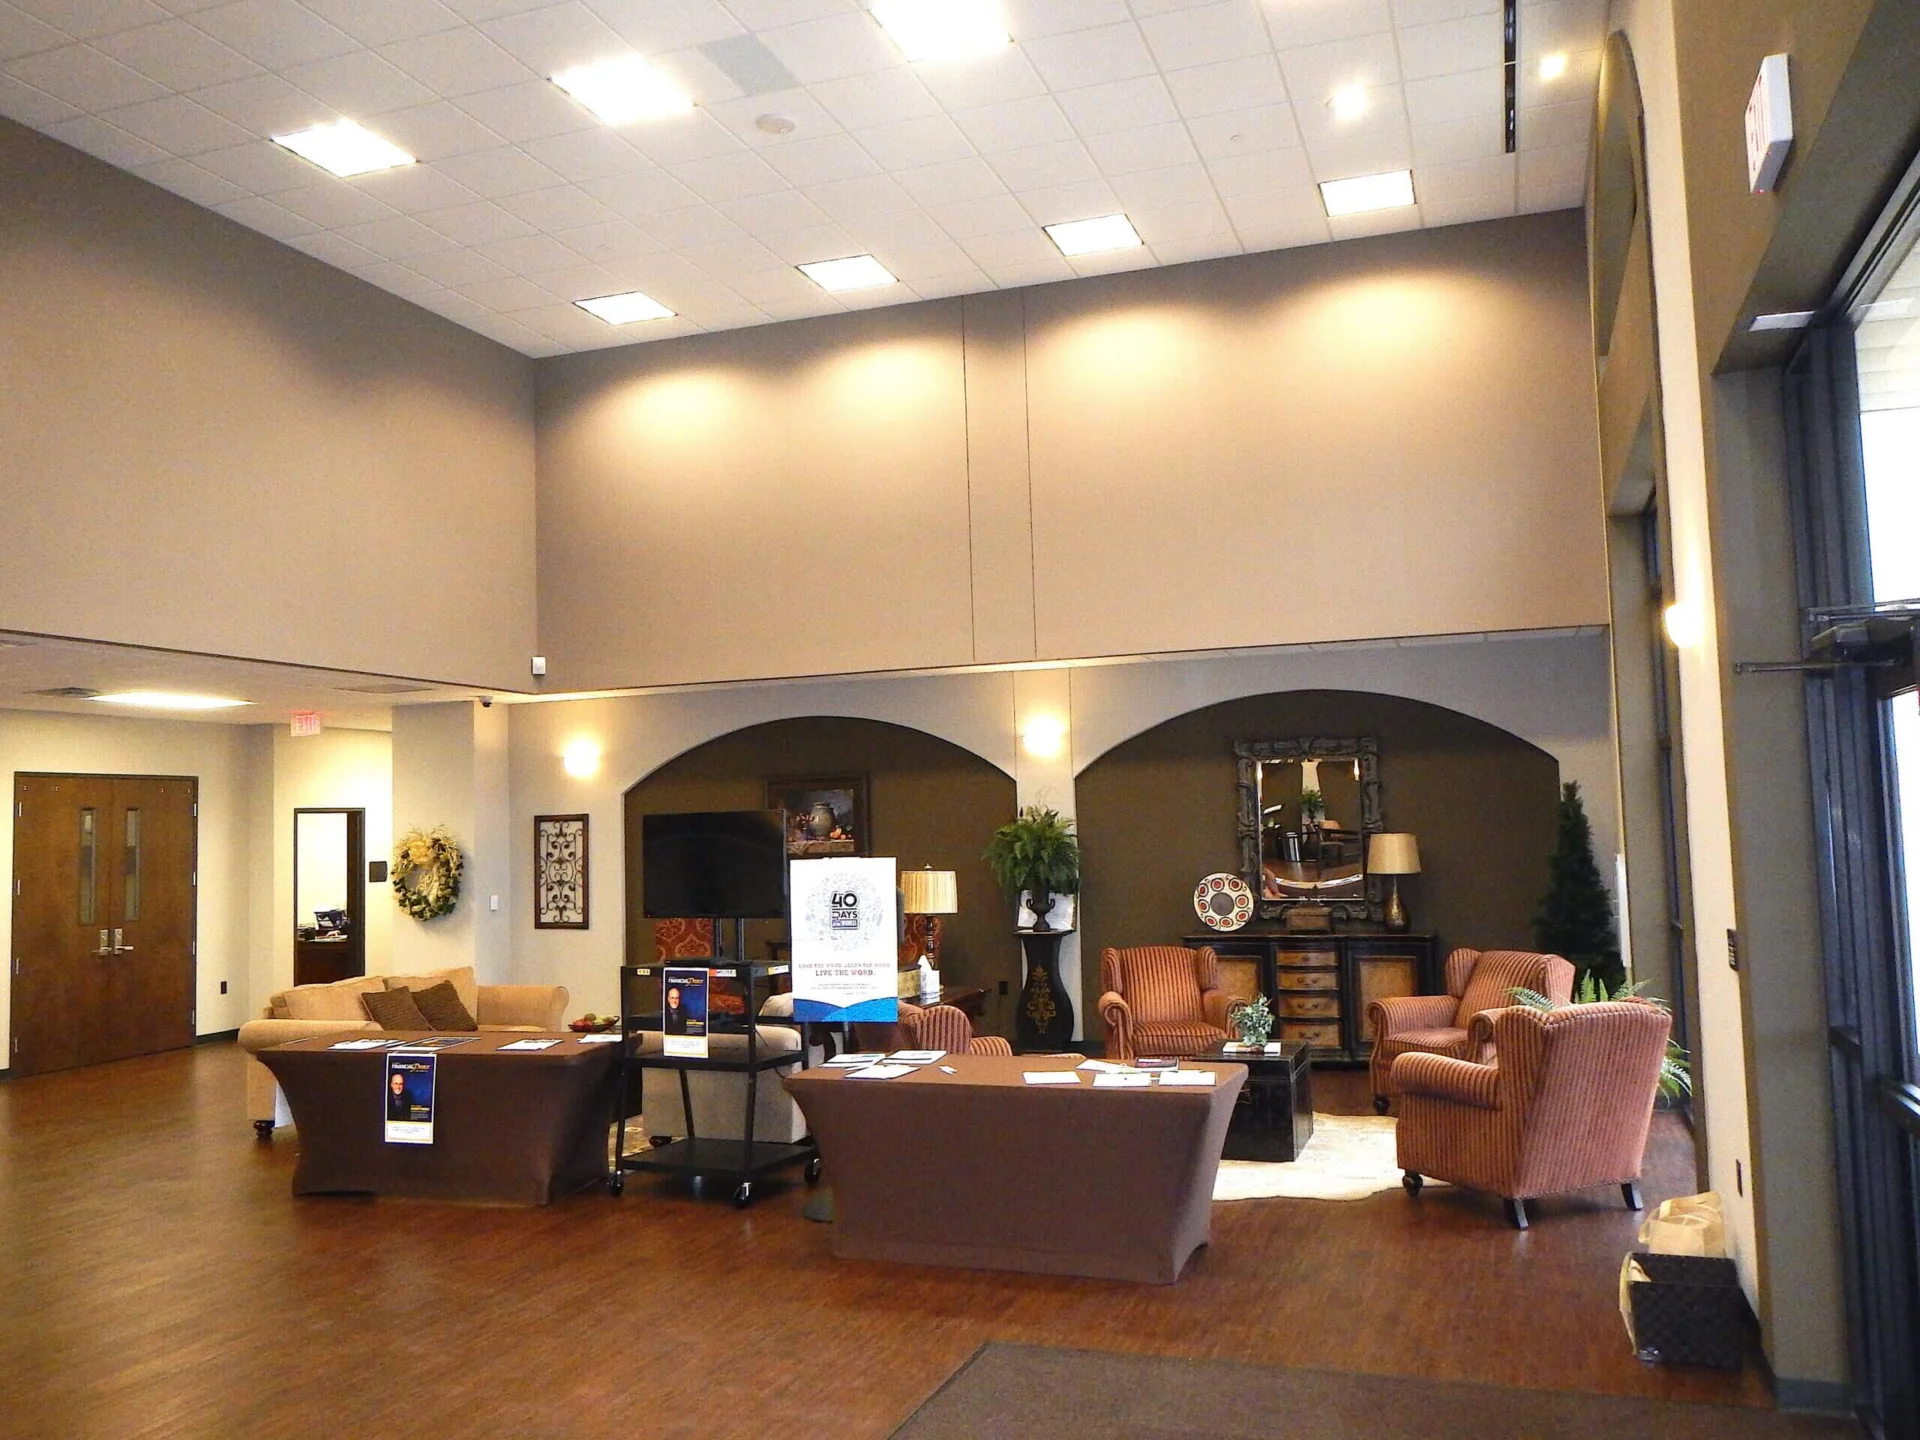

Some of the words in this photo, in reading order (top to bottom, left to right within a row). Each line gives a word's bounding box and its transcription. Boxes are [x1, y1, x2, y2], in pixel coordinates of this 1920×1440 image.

[831, 892, 858, 908] 40
[831, 910, 858, 919] DAYS
[815, 969, 833, 977] LIVE
